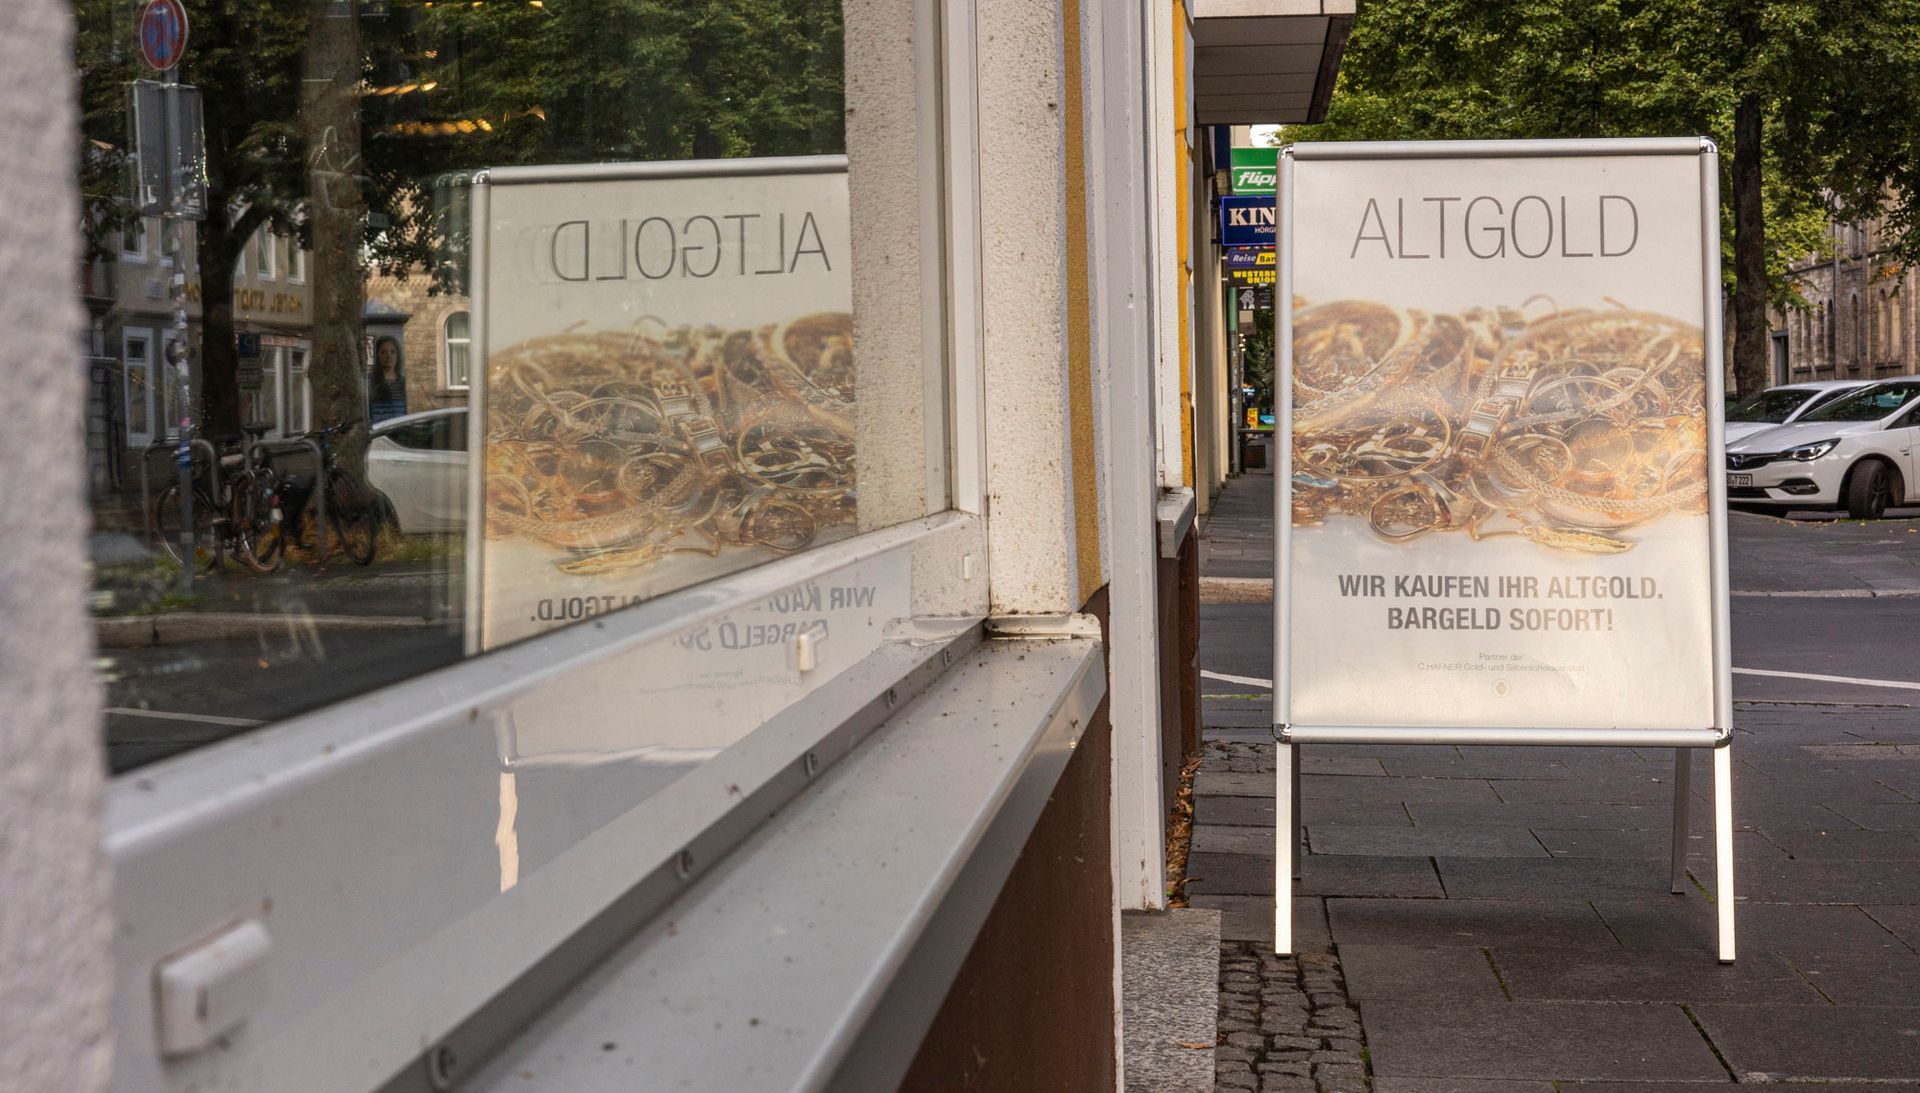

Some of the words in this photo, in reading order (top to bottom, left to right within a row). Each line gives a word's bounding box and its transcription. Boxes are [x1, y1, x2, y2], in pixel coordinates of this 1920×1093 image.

[1350, 195, 1639, 259] ALTGOLD
[1233, 270, 1276, 278] WESTERN
[1338, 574, 1385, 597] WIR
[1394, 575, 1489, 598] KAUFEN
[1498, 576, 1539, 599] IHR
[1547, 576, 1664, 600] ALTGOLD.
[1387, 607, 1501, 630] BARGELD
[1509, 608, 1614, 631] SOFORT!
[1479, 653, 1507, 661] Partner
[1510, 653, 1524, 661] der
